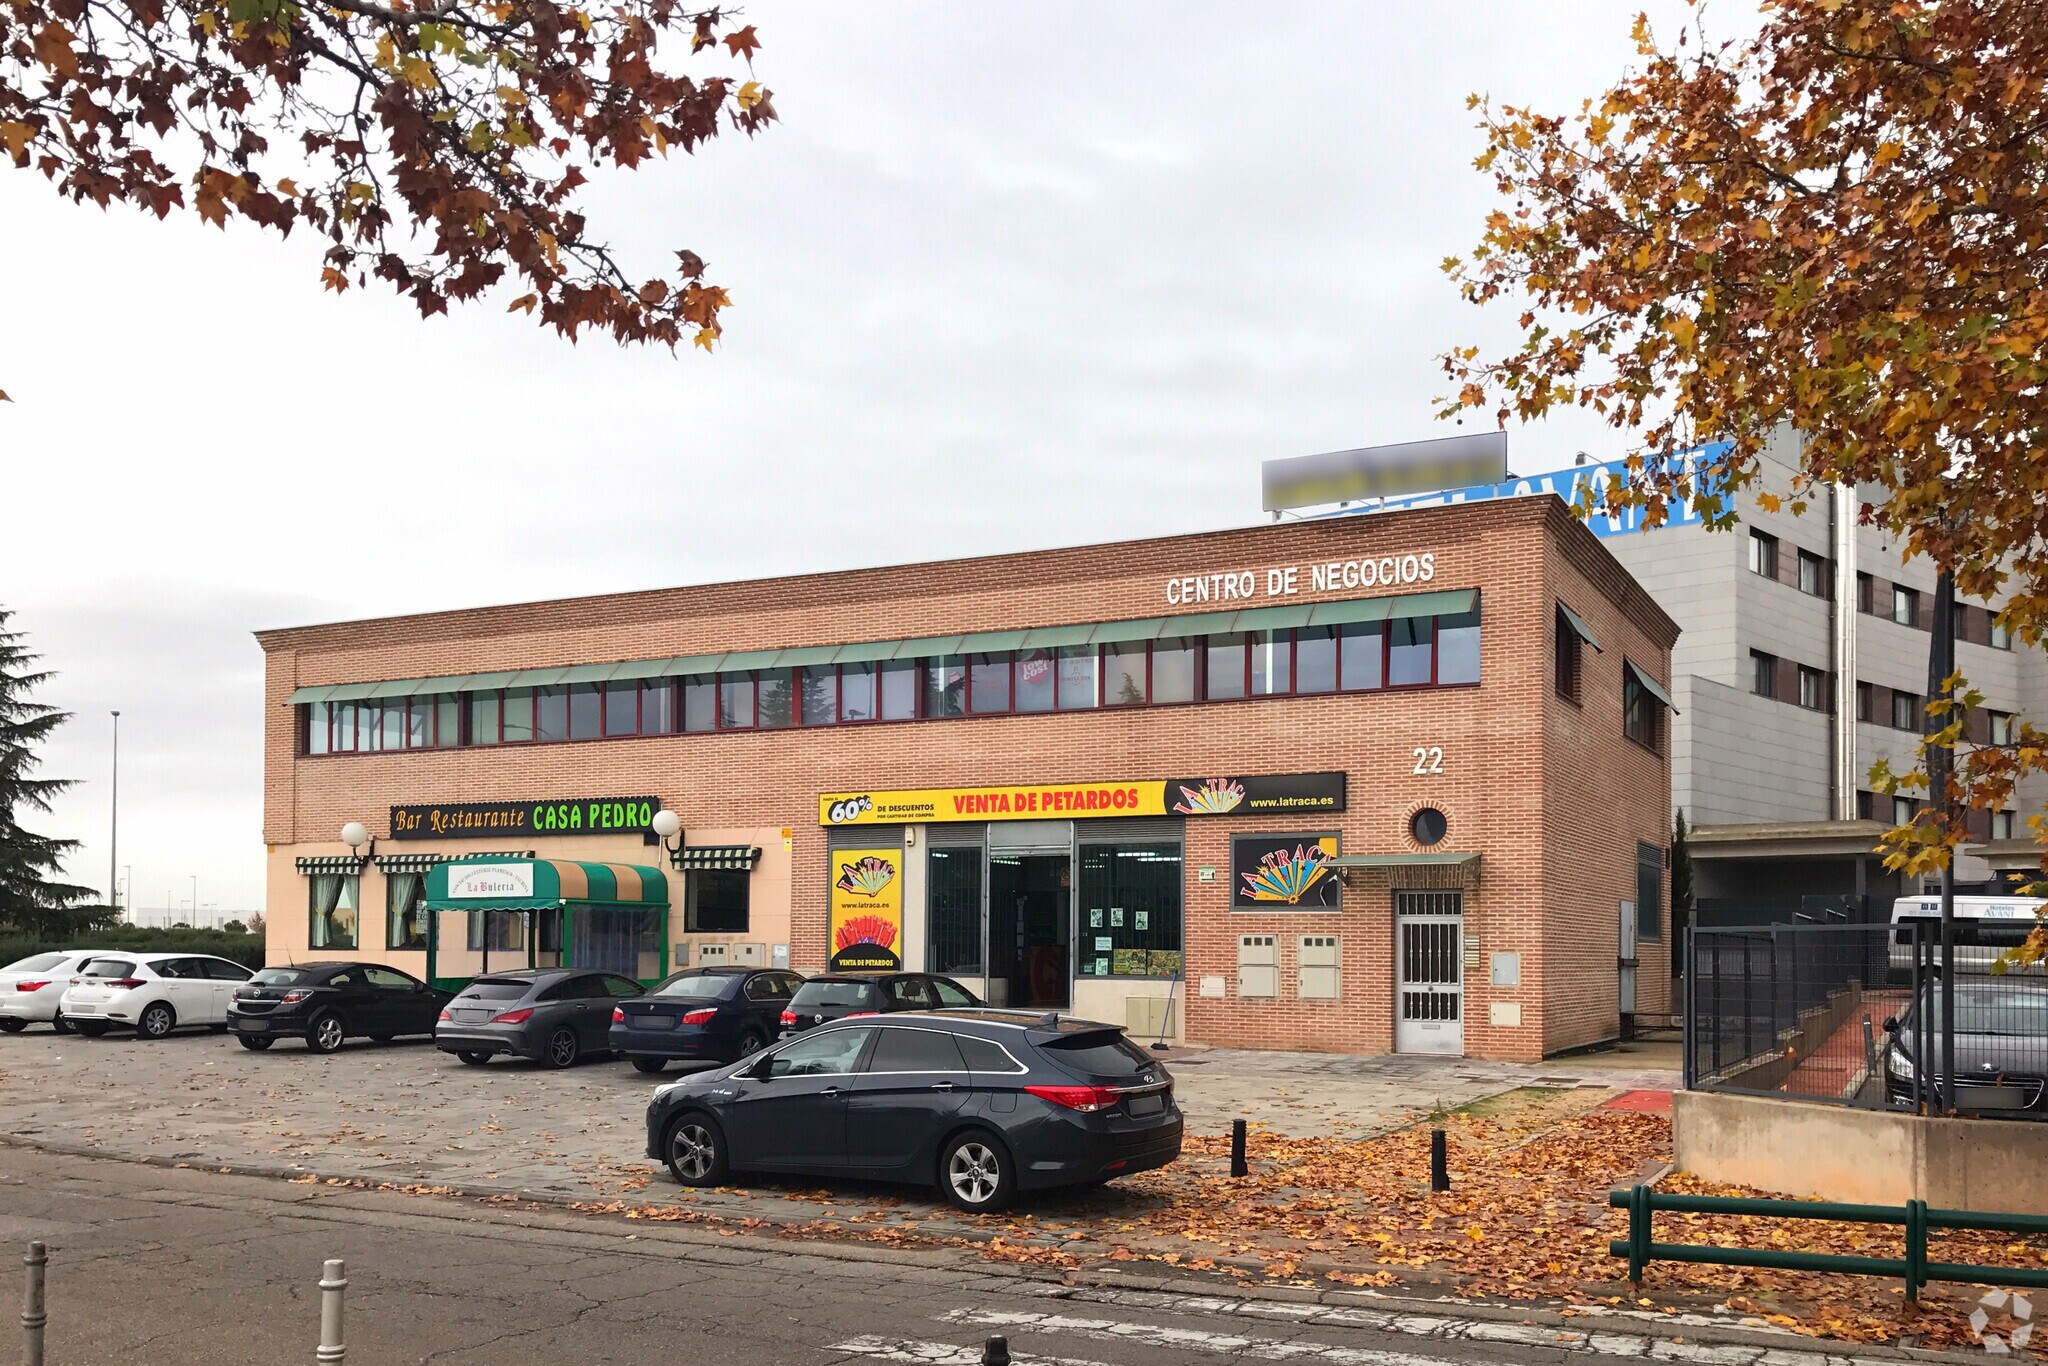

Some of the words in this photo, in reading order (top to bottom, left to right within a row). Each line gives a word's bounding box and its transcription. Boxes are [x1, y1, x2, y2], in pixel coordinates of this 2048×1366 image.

[1166, 571, 1255, 605] CENTRO
[1267, 567, 1298, 596] DE
[1312, 553, 1435, 591] NEGOCIOS
[1023, 660, 1048, 680] cost
[1412, 747, 1444, 775] 22
[828, 795, 873, 823] 60%
[889, 804, 935, 812] DESCUENTOS
[953, 793, 1011, 814] VENTA
[1014, 792, 1037, 812] DE
[1041, 788, 1139, 811] PETARDOS
[1250, 796, 1334, 808] www.latraca.es
[395, 810, 423, 831] Bar
[430, 807, 525, 833] Restaurante
[533, 805, 582, 831] CASA
[588, 802, 651, 829] PEDRO
[467, 882, 478, 892] La
[1240, 872, 1260, 900] LA
